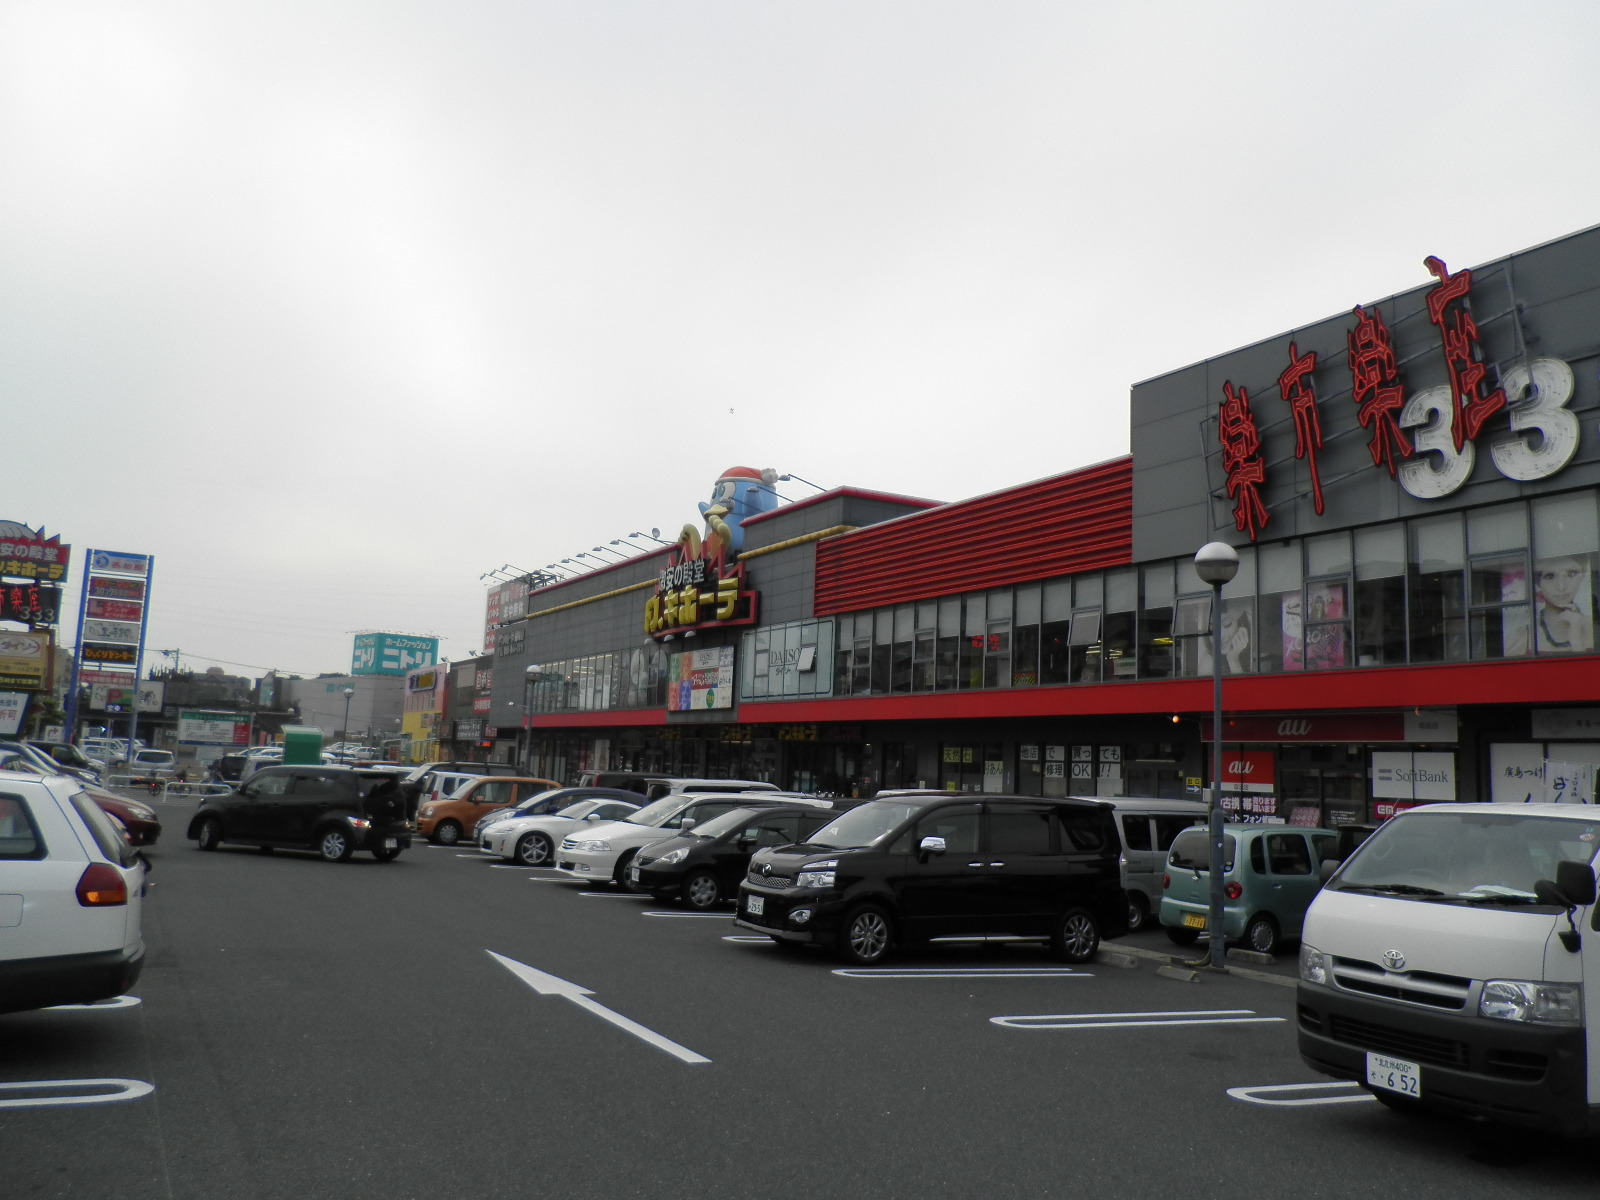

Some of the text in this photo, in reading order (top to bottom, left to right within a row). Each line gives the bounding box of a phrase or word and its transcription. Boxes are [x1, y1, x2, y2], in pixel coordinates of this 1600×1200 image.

[382, 648, 432, 669] ニトリ
[1277, 719, 1311, 736] au
[1072, 764, 1090, 776] OK
[1228, 760, 1254, 774] au
[1187, 777, 1201, 785] 出口
[1395, 769, 1448, 784] SoftBank
